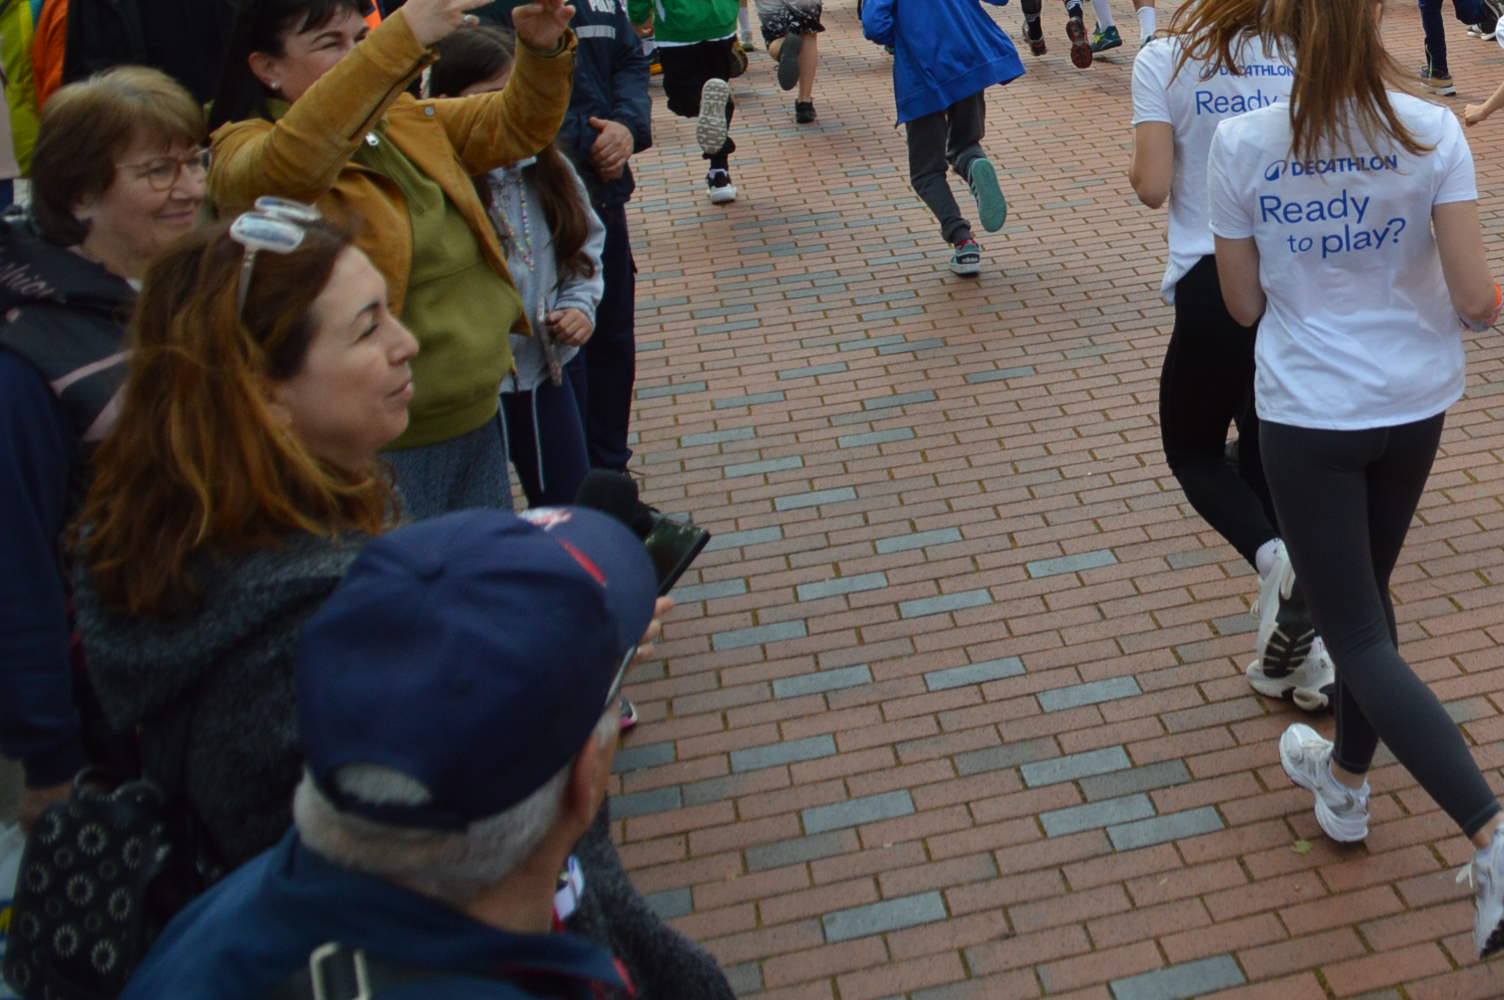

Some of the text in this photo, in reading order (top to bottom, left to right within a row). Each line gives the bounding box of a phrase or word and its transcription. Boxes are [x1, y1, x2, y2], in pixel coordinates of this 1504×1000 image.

[1291, 155, 1398, 176] DECATHLON
[1259, 189, 1370, 224] Ready
[1287, 217, 1406, 259] to play?
